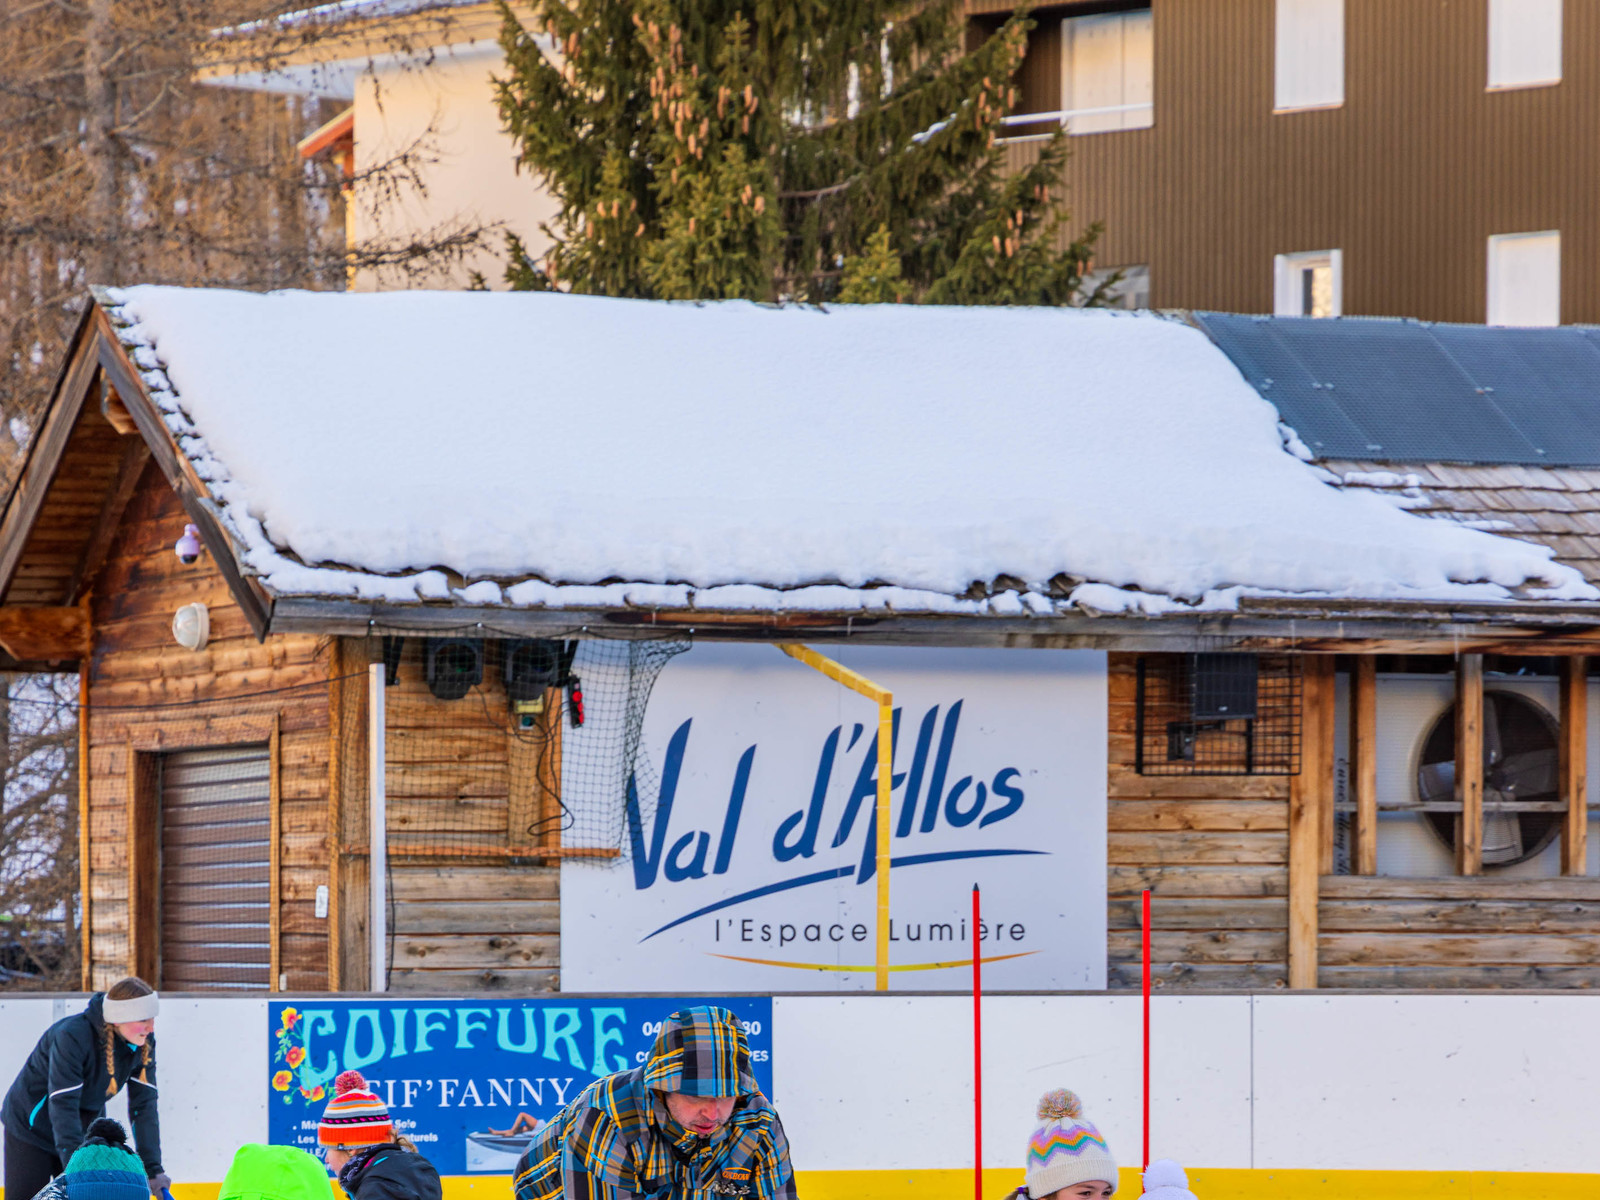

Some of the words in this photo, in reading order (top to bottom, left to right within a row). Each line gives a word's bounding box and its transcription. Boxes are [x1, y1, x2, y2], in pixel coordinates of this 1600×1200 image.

[627, 717, 757, 890] Val
[772, 698, 1025, 885] d'Allos
[715, 919, 868, 947] l'Espace
[889, 918, 1025, 942] Lumière
[299, 1007, 628, 1090] COIFFURE
[642, 1021, 662, 1036] 04
